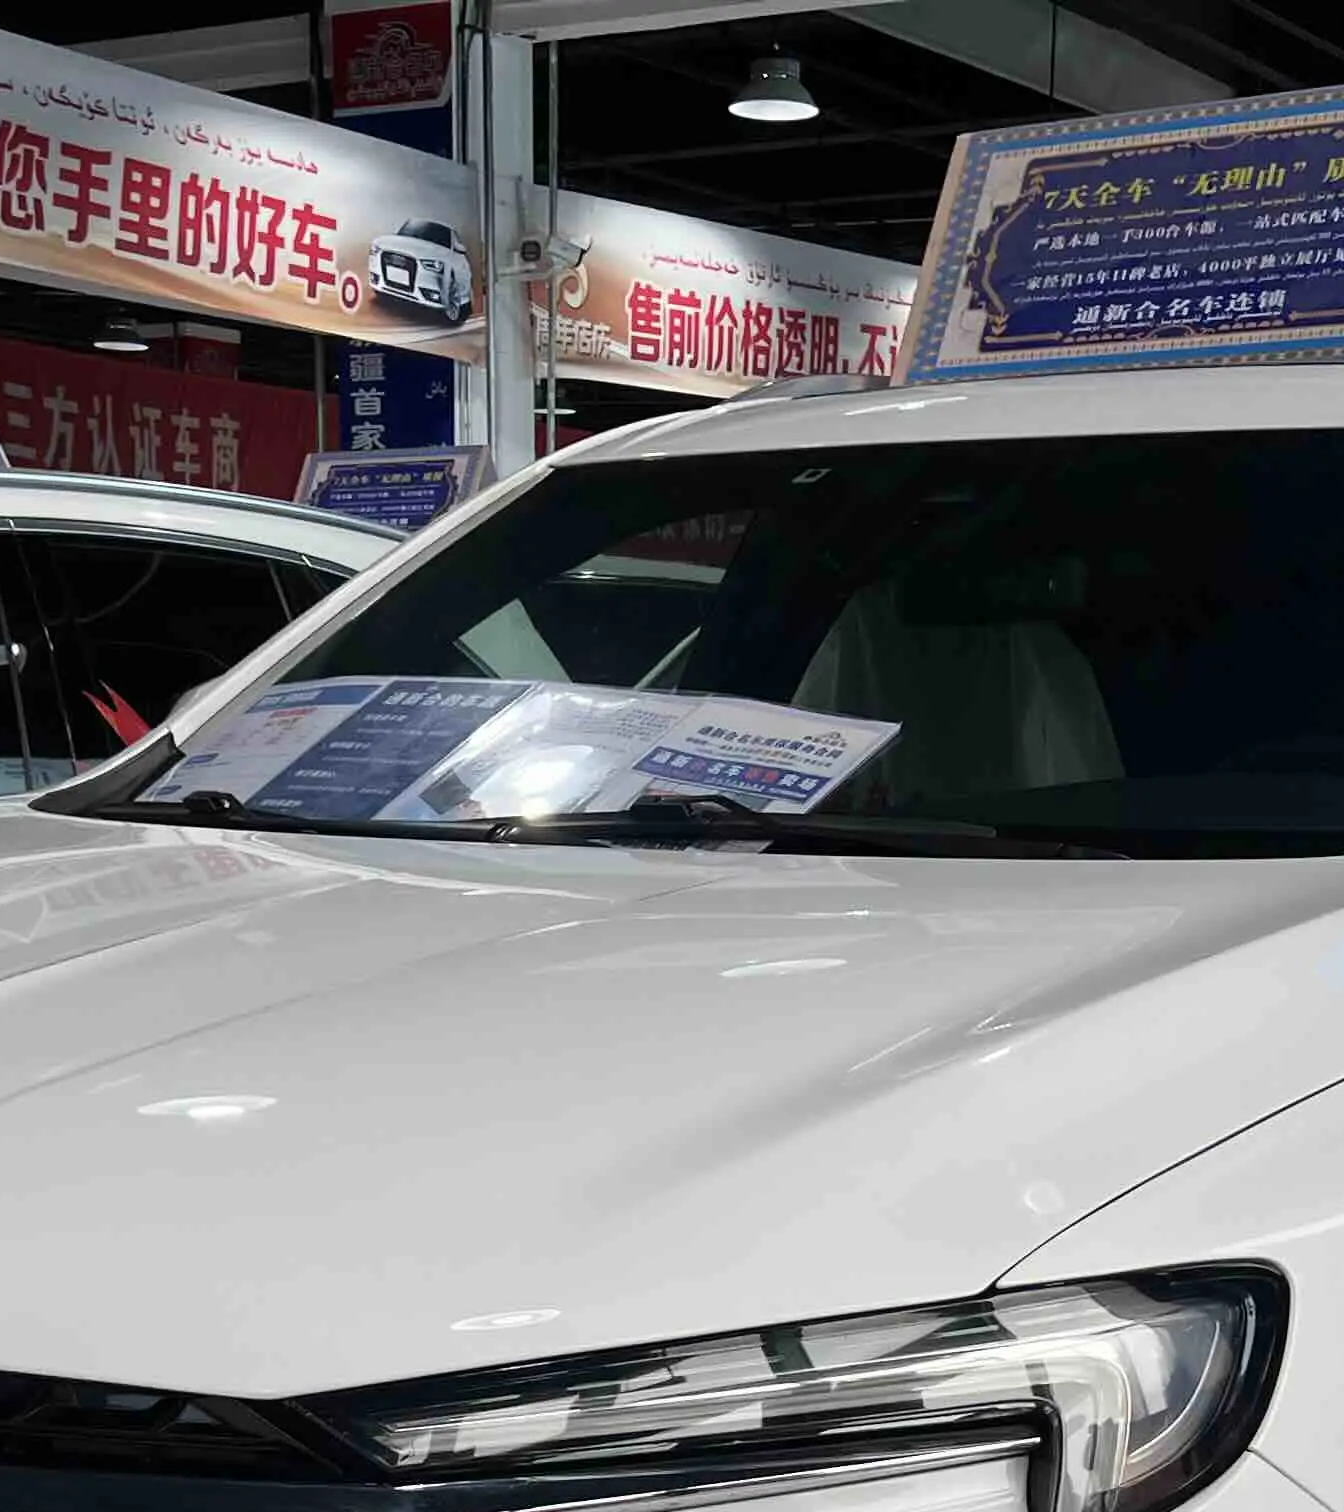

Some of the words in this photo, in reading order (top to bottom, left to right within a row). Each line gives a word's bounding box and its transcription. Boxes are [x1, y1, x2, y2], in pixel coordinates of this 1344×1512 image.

[1071, 288, 1288, 325] 通新合名车连锁
[348, 338, 387, 450] 疆首家
